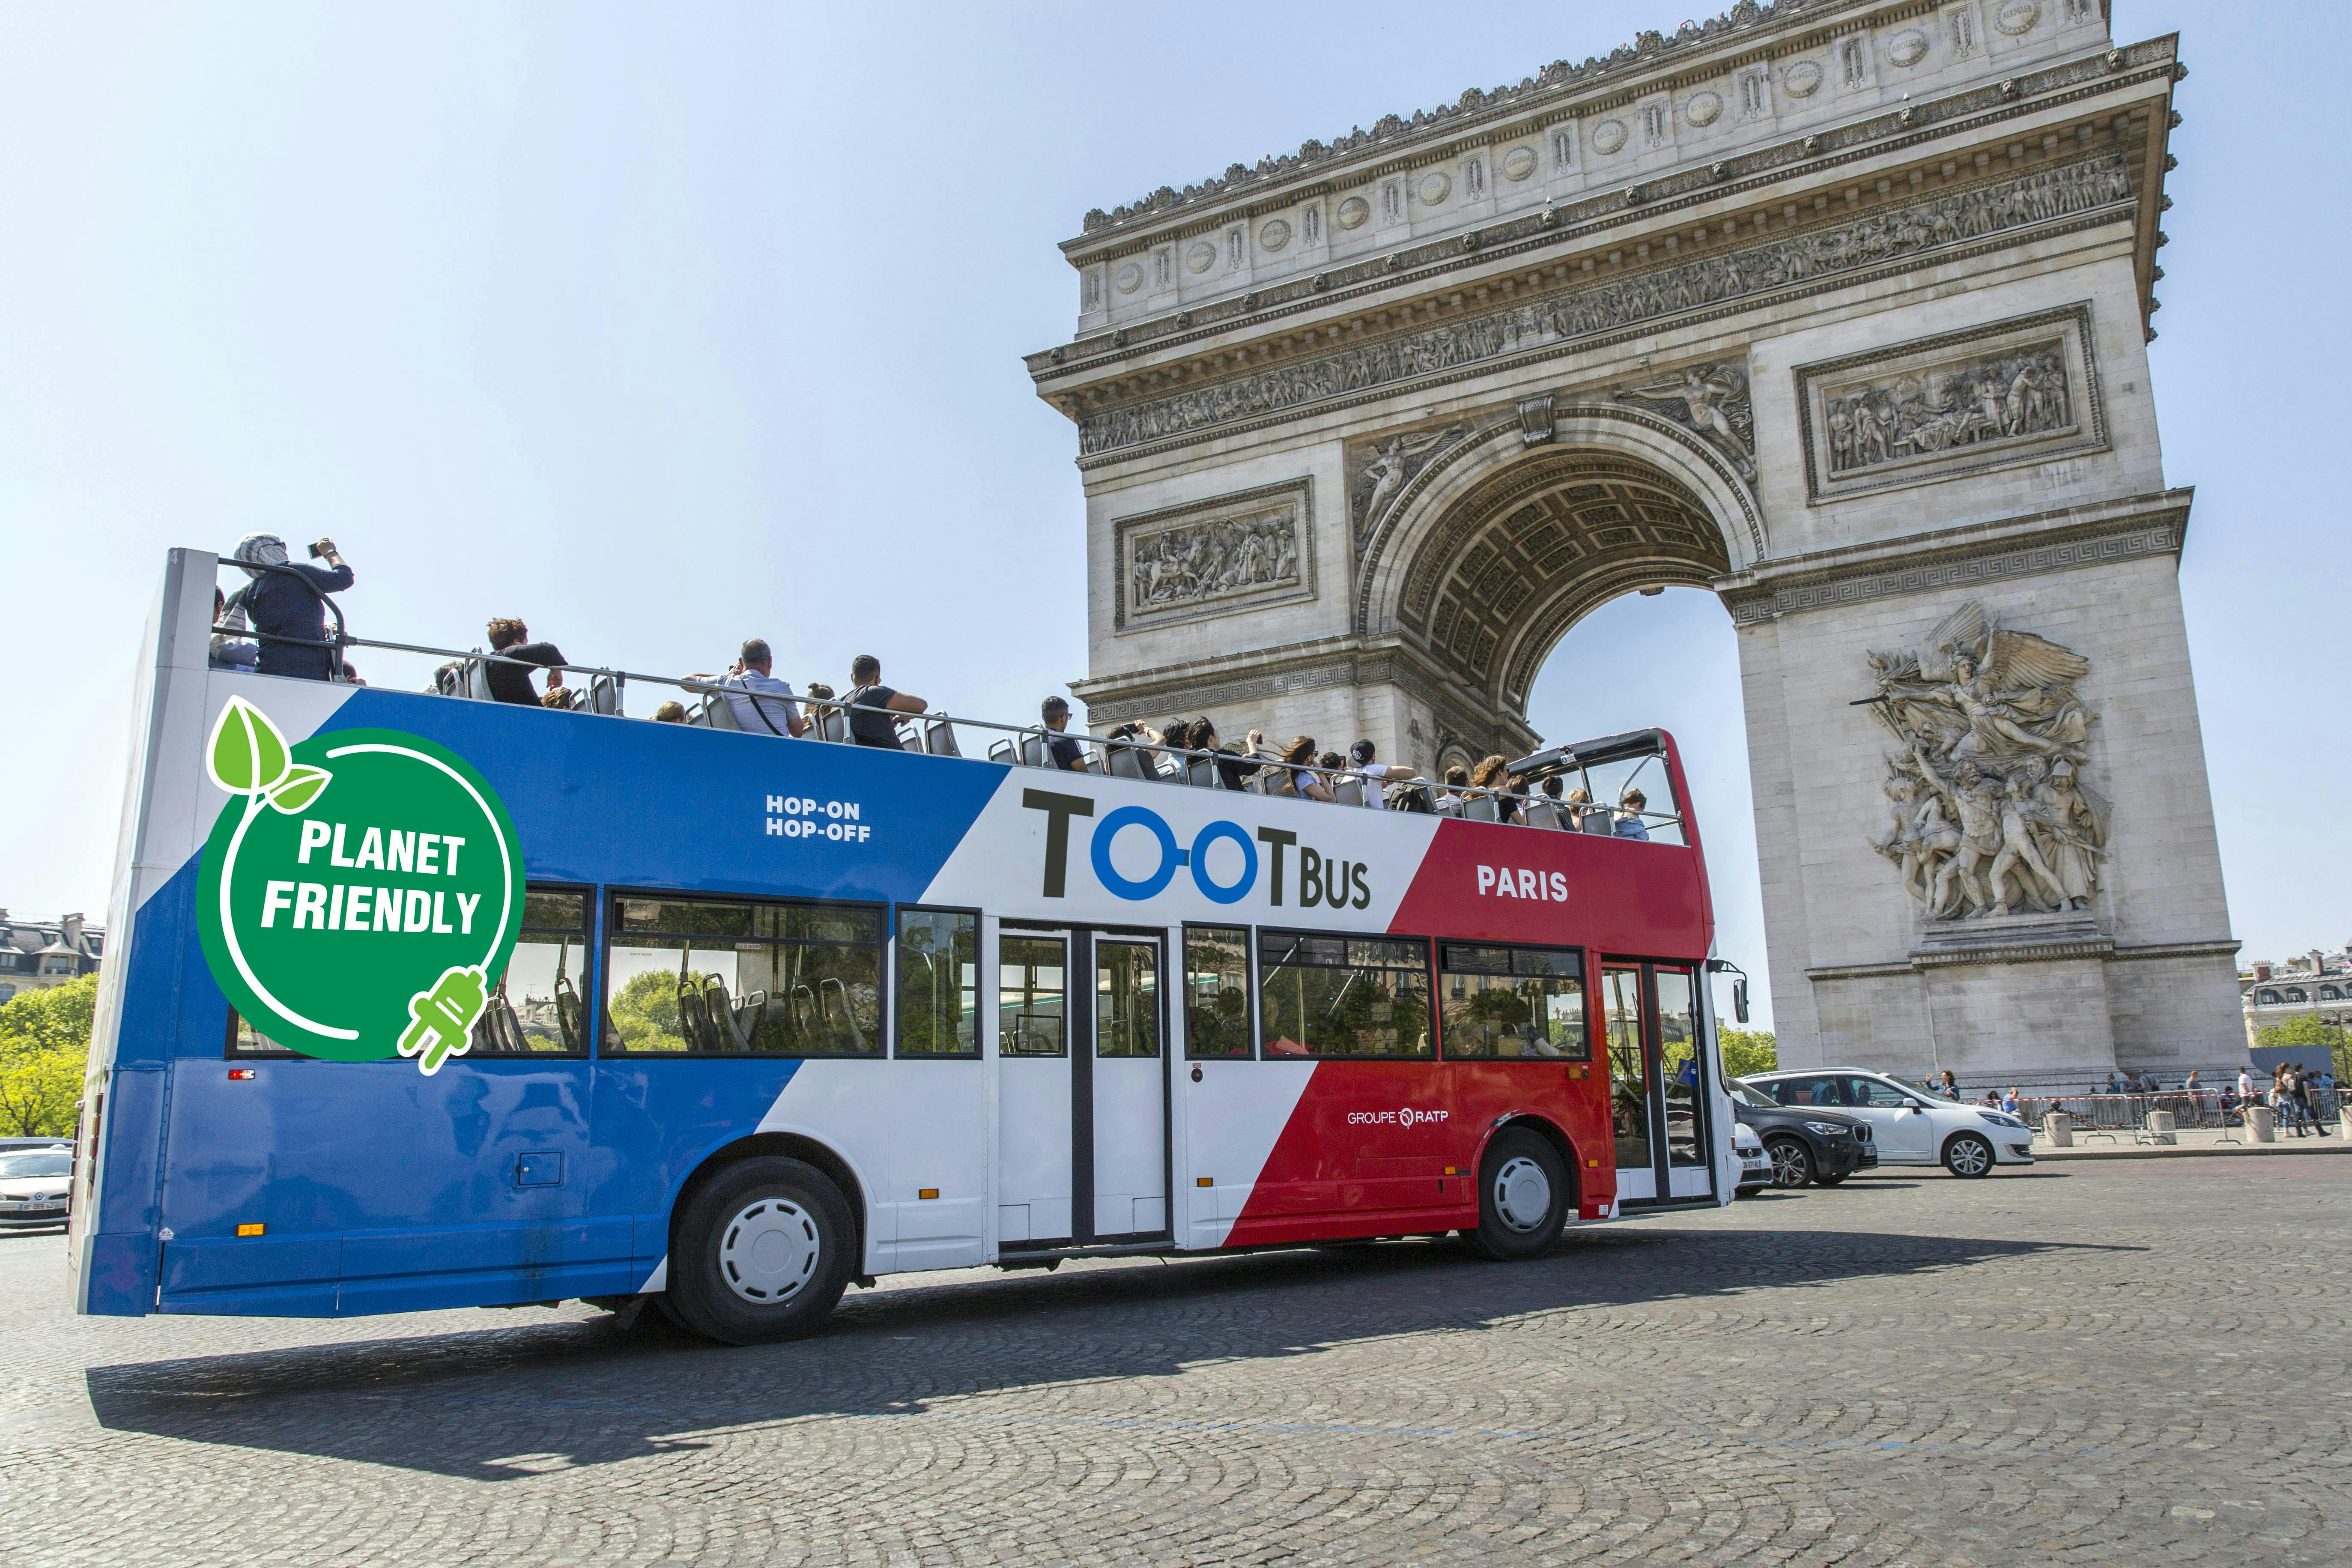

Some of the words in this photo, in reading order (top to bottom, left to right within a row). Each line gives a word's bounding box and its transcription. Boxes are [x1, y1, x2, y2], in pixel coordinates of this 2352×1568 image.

[1892, 38, 1922, 54] ABOUKIR
[1691, 100, 1713, 113] RIVOLI
[1596, 128, 1619, 141] ARCOLE
[1425, 181, 1440, 191] LODI
[1263, 228, 1284, 240] FLEURUS
[767, 795, 859, 820] HOP-ON
[767, 818, 870, 842] HOP-OFF
[1477, 865, 1568, 902] PARIS
[1347, 1111, 1396, 1125] GROUPE
[1415, 1111, 1448, 1123] RATP
